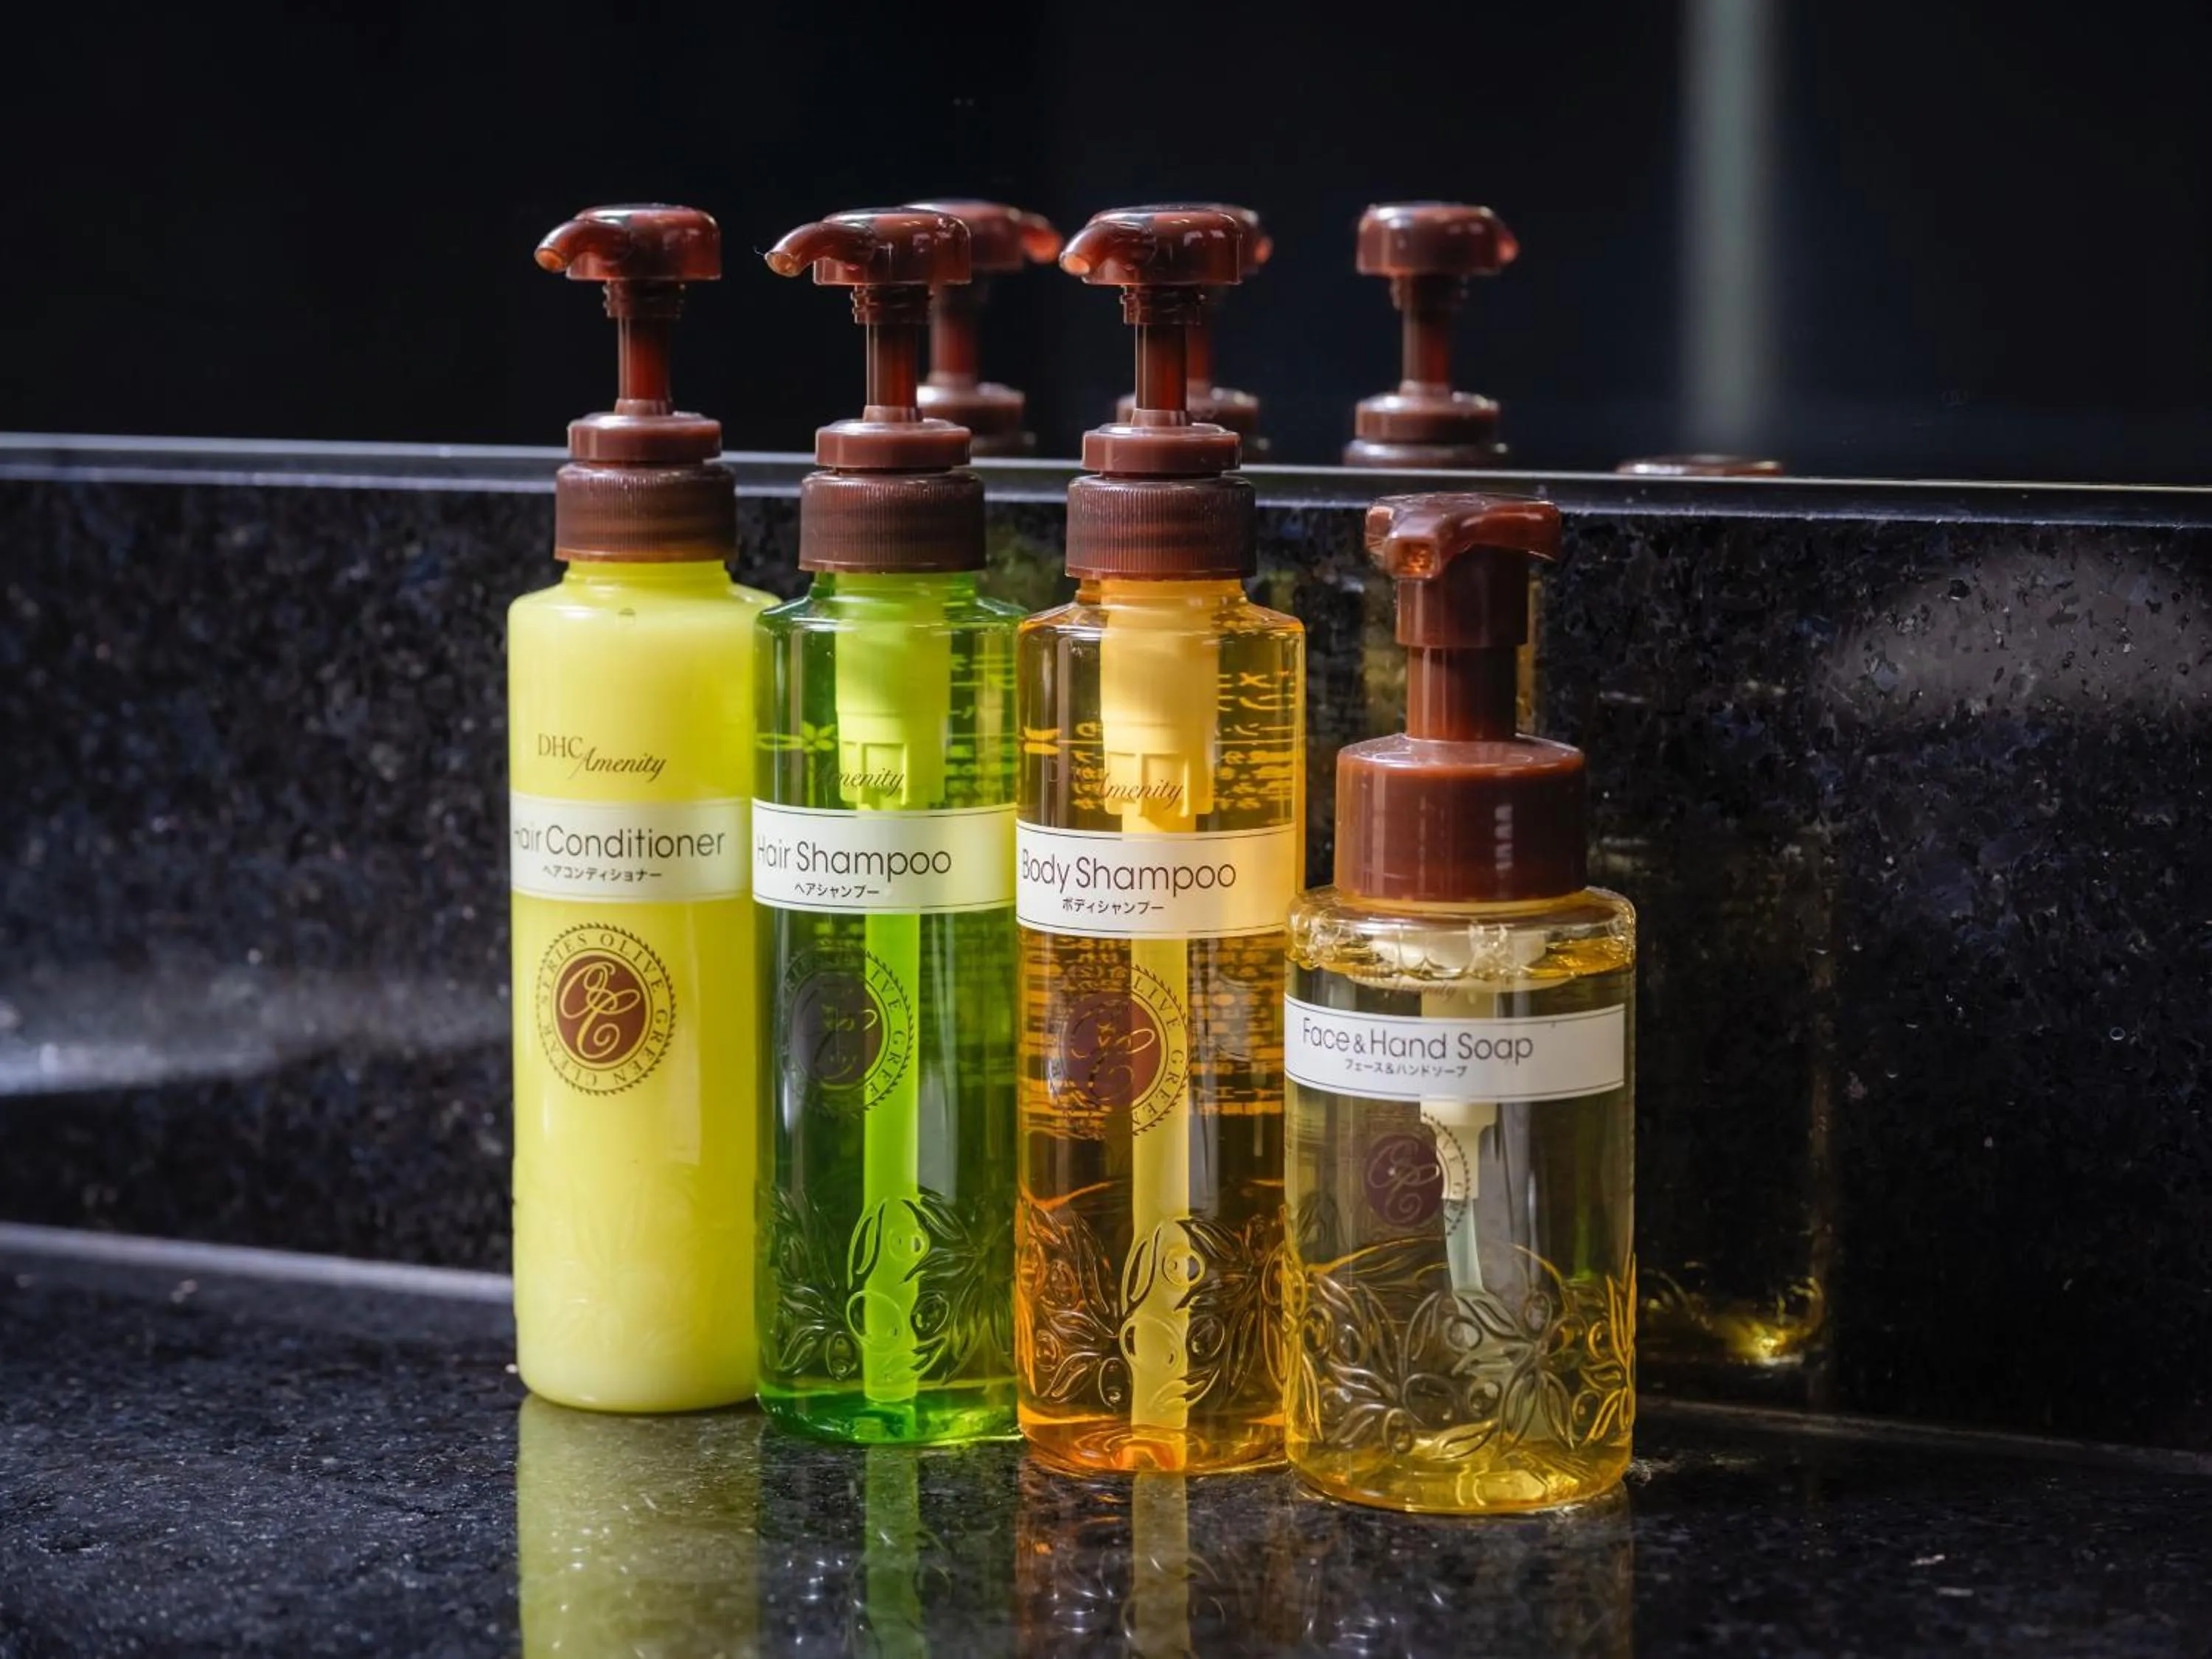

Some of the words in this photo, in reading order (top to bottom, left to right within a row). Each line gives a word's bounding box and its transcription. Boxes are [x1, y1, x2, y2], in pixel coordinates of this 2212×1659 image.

[537, 733, 583, 759] DHC
[567, 747, 667, 783] Amenity
[546, 824, 726, 860] Conditioner
[756, 834, 790, 871] Hair
[796, 840, 952, 883] Shampoo
[543, 864, 663, 883] ヘアコンディショナー
[794, 883, 880, 900] ヘアシャンプー
[1022, 848, 1070, 894] Body
[1076, 856, 1237, 897] Shampoo
[1062, 897, 1165, 915] ボディシャンプー
[599, 933, 664, 993] OLIVE
[613, 1008, 668, 1085] GREEN
[1458, 1032, 1534, 1065] Soap
